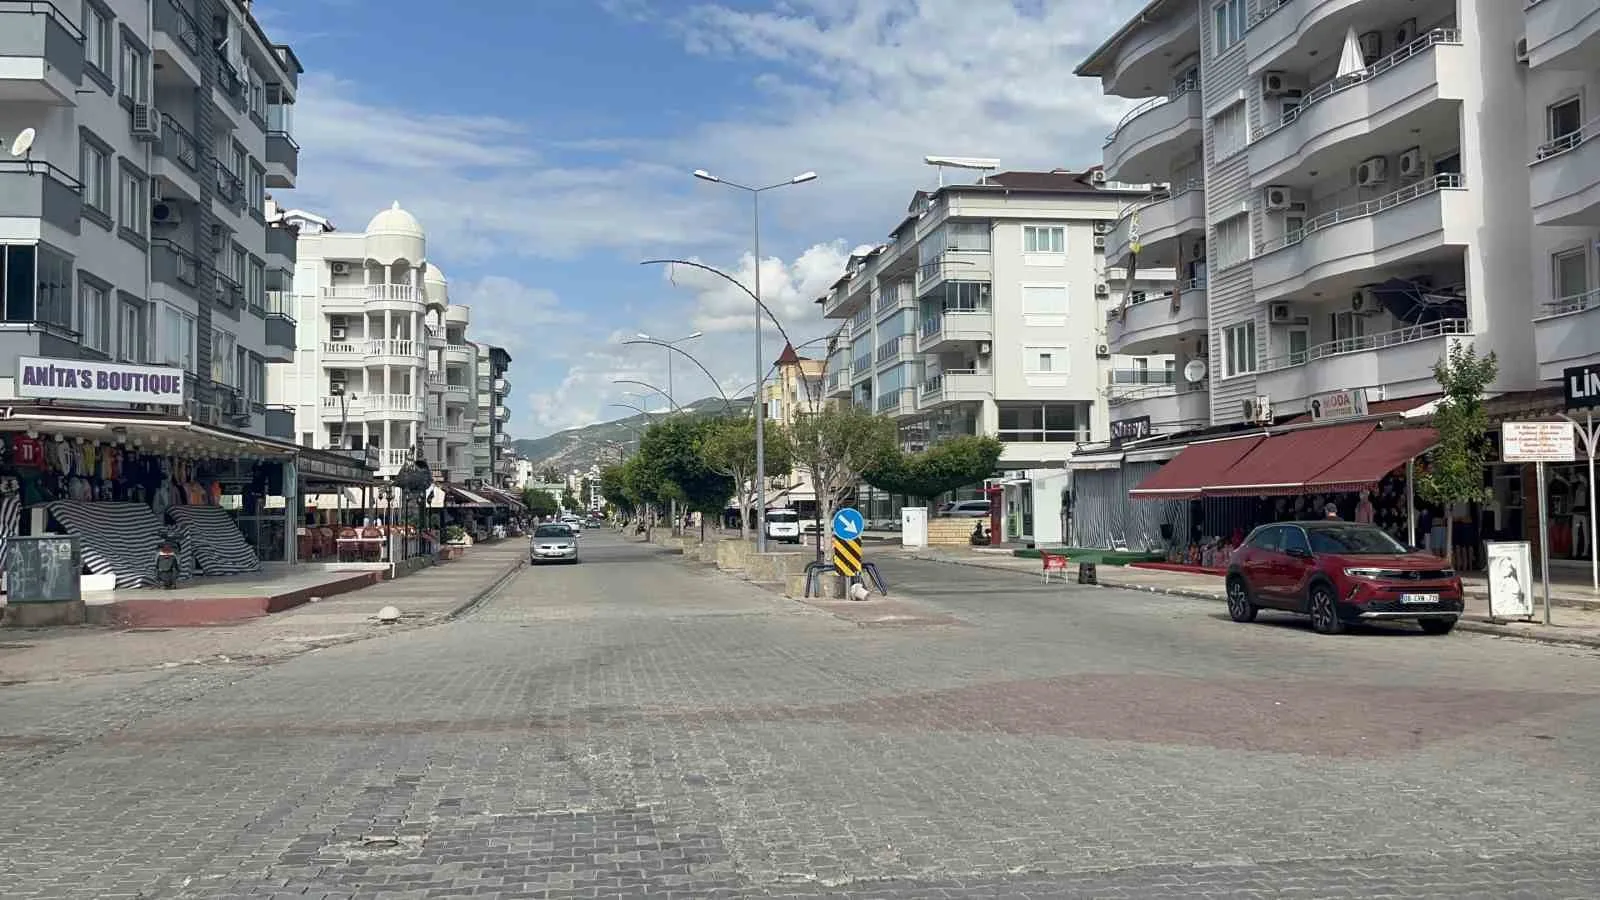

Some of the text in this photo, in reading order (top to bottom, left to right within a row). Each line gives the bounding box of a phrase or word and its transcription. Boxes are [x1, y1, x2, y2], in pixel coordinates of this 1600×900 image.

[23, 364, 181, 395] ANİTA'S BOUTIQUE
[1322, 394, 1351, 409] MODA
[22, 444, 33, 460] 11
